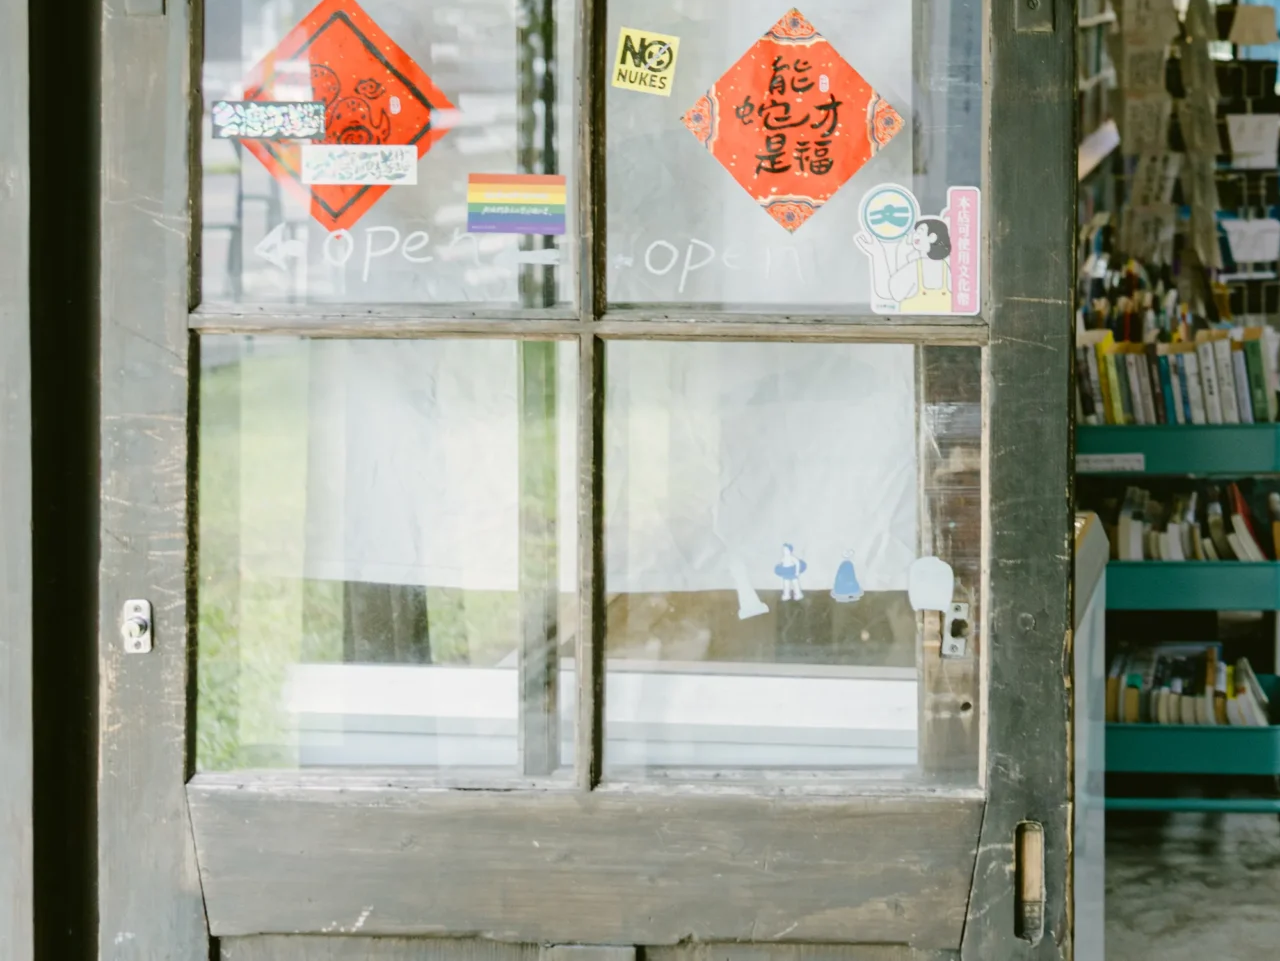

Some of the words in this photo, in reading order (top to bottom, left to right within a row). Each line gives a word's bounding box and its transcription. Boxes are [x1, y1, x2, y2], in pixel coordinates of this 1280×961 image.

[620, 35, 673, 73] NO
[617, 68, 667, 90] NUKES
[769, 55, 815, 95] 能
